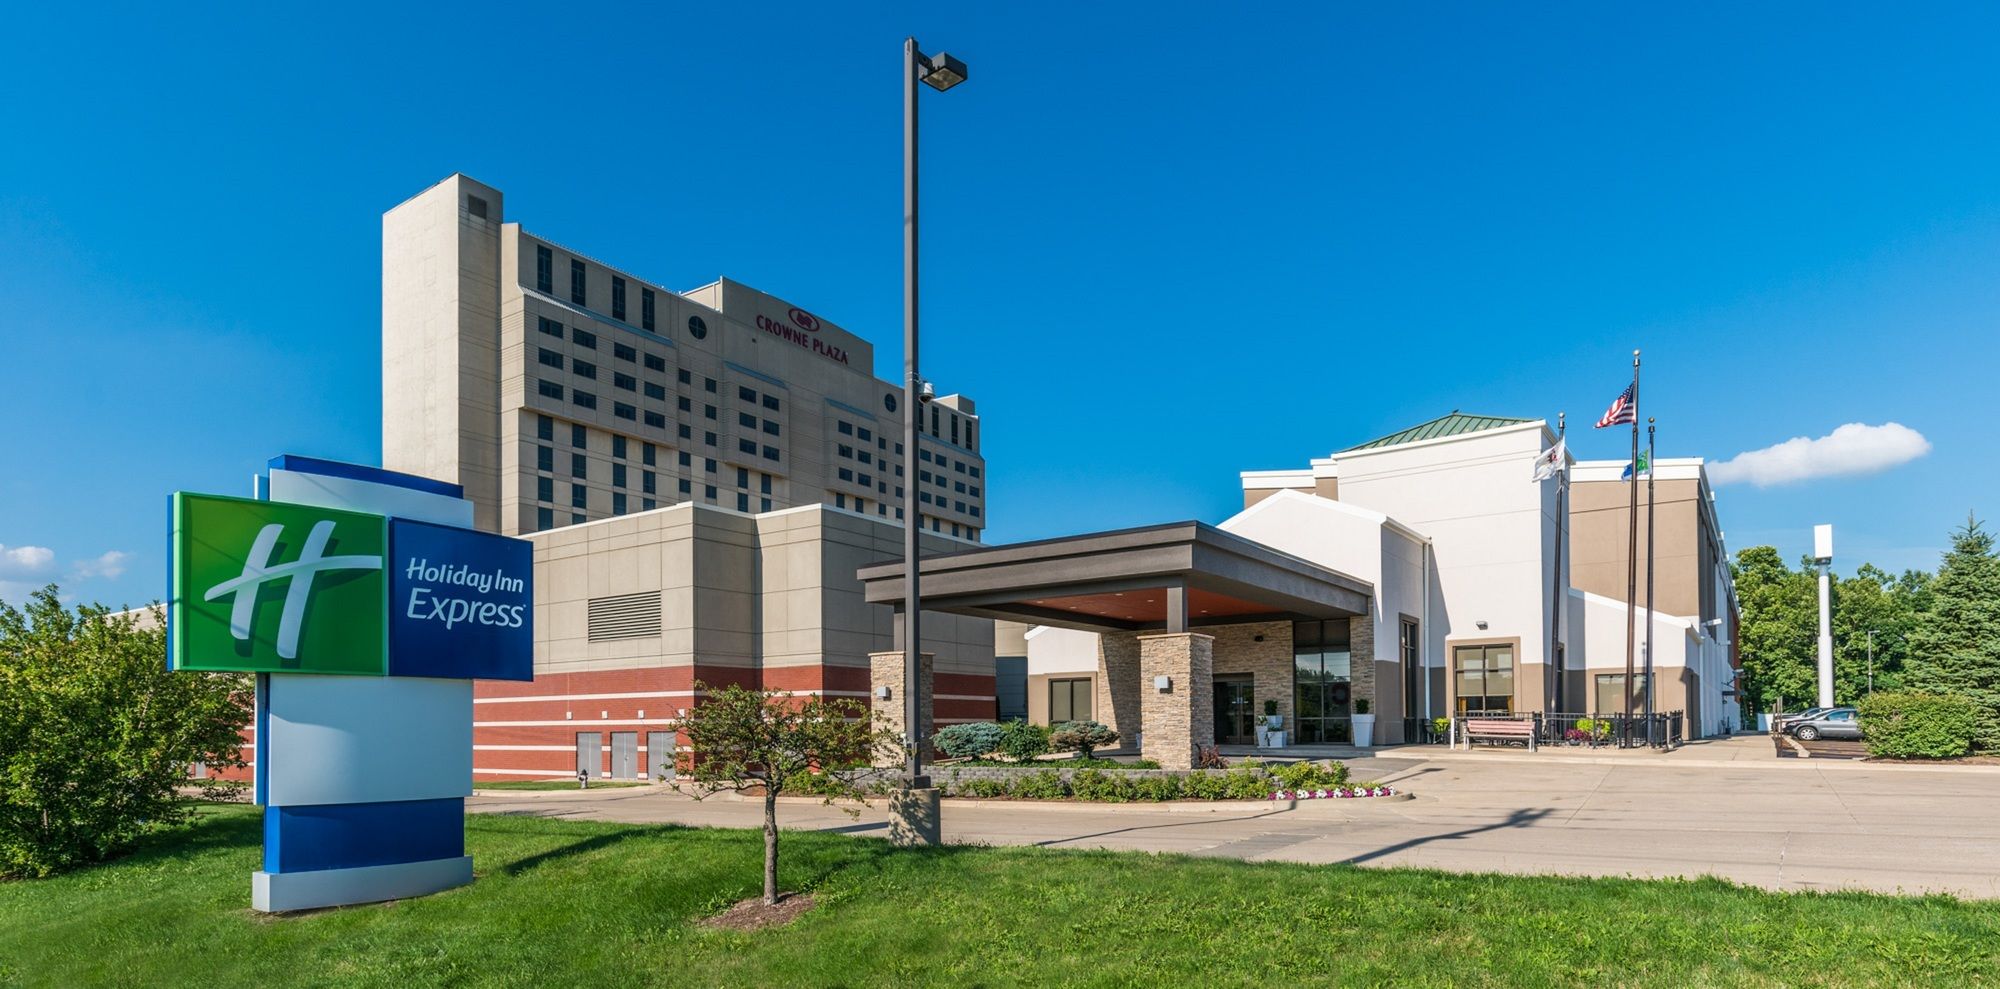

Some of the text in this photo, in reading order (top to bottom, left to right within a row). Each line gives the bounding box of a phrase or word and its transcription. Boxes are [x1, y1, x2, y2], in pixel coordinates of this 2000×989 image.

[756, 314, 848, 366] CROWNE PLAZA
[204, 520, 382, 658] H
[406, 557, 524, 594] Holiday Inn
[406, 587, 525, 630] Express
